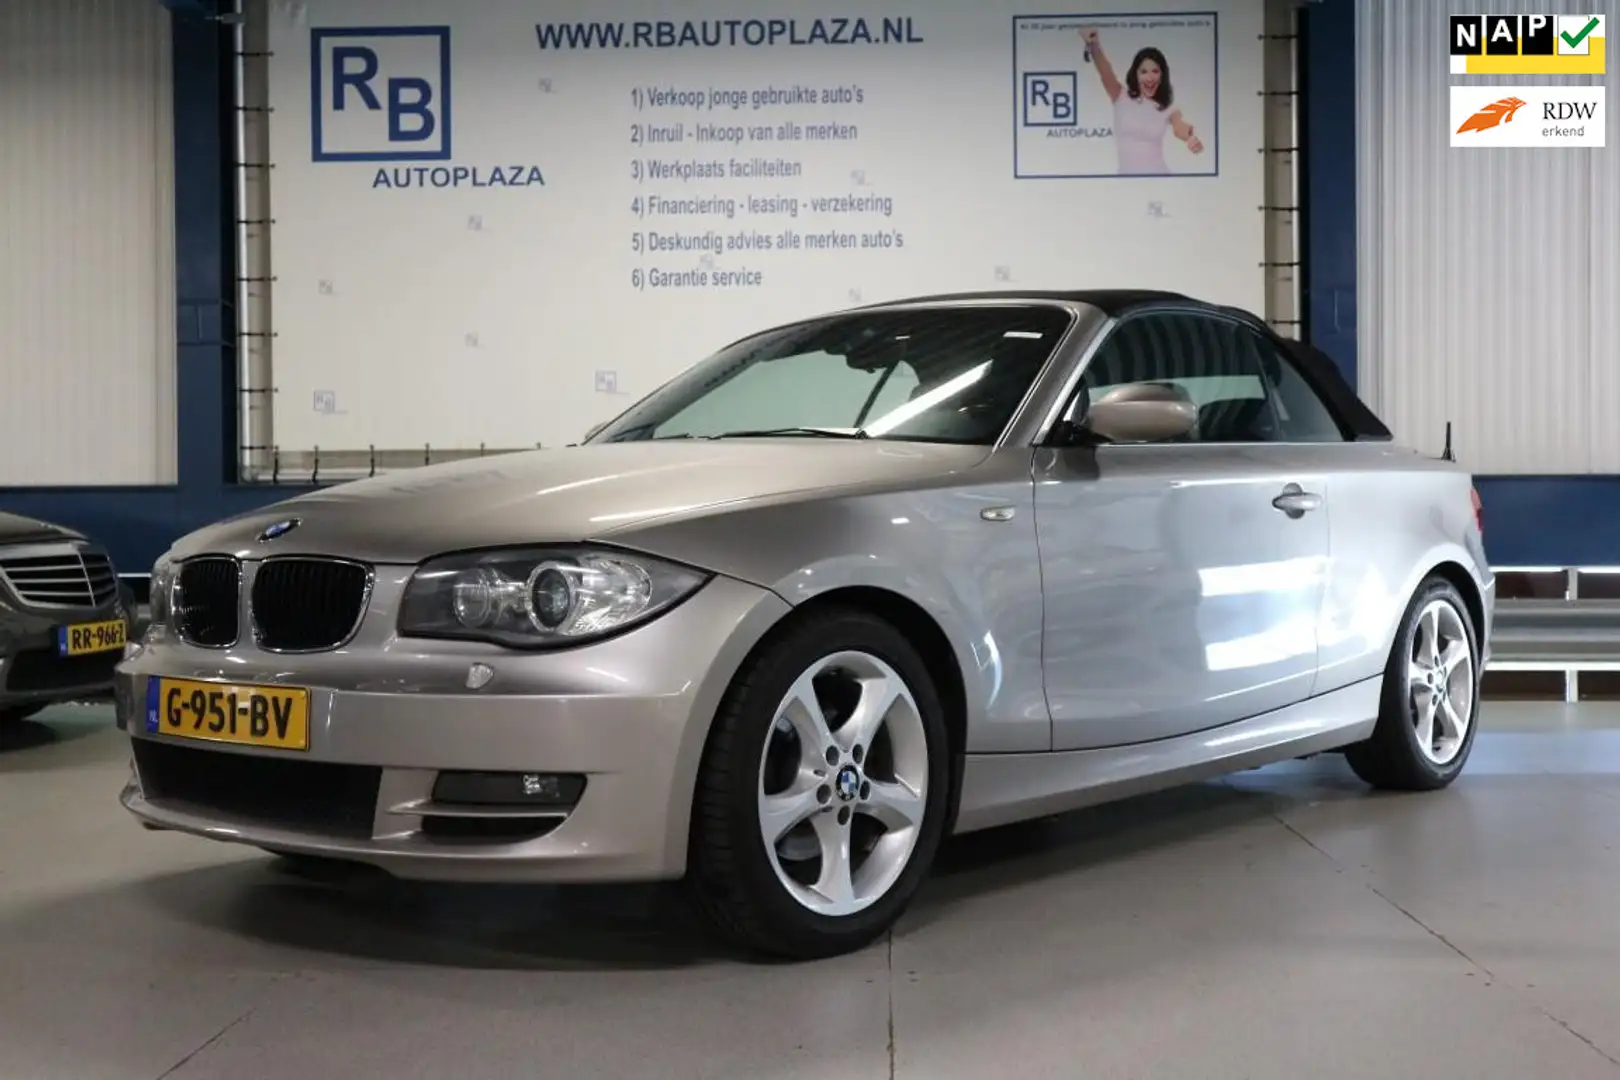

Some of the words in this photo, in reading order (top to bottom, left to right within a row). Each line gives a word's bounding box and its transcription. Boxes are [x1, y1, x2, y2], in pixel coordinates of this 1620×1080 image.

[535, 17, 923, 49] WWW.RBAUTOPLAZA.NL
[631, 87, 644, 111] 1)
[647, 86, 705, 111] Verkoop
[708, 87, 748, 110] jonge
[752, 85, 818, 110] gebruikte
[821, 84, 864, 104] auto's
[630, 124, 644, 147] 2)
[648, 123, 683, 142] Inruil
[696, 123, 744, 145] Inkoop
[748, 126, 773, 141] van
[776, 122, 802, 141] alle
[805, 122, 858, 140] merken
[1046, 127, 1114, 139] AUTOPLAZA
[372, 166, 545, 188] AUTOPLAZA
[631, 160, 644, 183] 3)
[648, 159, 725, 182] Werkplaats
[729, 157, 802, 179] faciliteiten
[630, 196, 644, 220] 4)
[648, 194, 735, 219] Financiering
[748, 193, 798, 218] leasing
[811, 193, 893, 217] verzekering
[631, 232, 645, 256] 5)
[648, 231, 723, 255] Deskundig
[727, 229, 773, 250] advies
[776, 229, 800, 249] alle
[805, 229, 857, 249] merken
[861, 228, 904, 248] auto's
[631, 268, 645, 292] 6)
[648, 267, 708, 287] Garantie
[711, 266, 762, 286] service
[167, 687, 293, 740] G-951-BV
